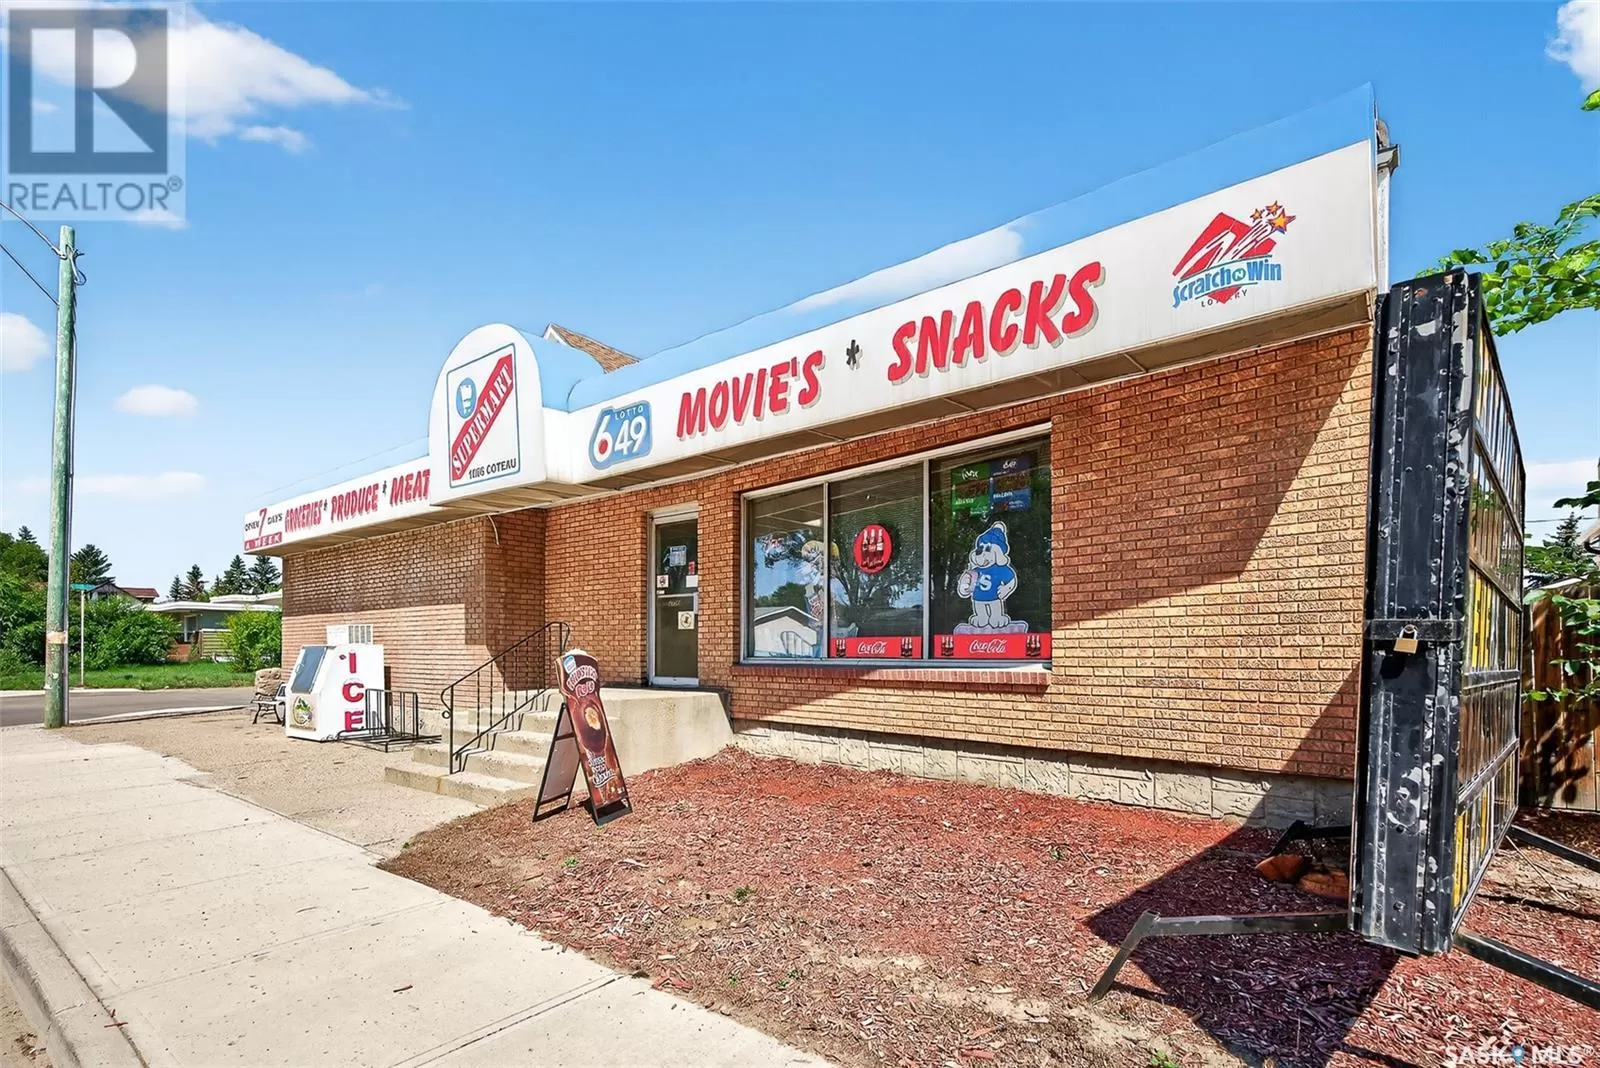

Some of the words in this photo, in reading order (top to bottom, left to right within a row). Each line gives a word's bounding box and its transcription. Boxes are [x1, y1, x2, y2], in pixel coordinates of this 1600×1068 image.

[1172, 266, 1230, 309] Scratch
[1246, 259, 1282, 281] Win
[676, 350, 825, 441] MOVIE'S
[887, 261, 1106, 386] SNACKS
[453, 363, 513, 476] SUPERMART
[615, 405, 644, 420] LOTTO
[593, 414, 647, 463] 649
[486, 458, 517, 475] COTEAU
[284, 499, 323, 533] GROCERIES
[331, 483, 379, 523] PRODUCE
[389, 468, 431, 507] MEAT
